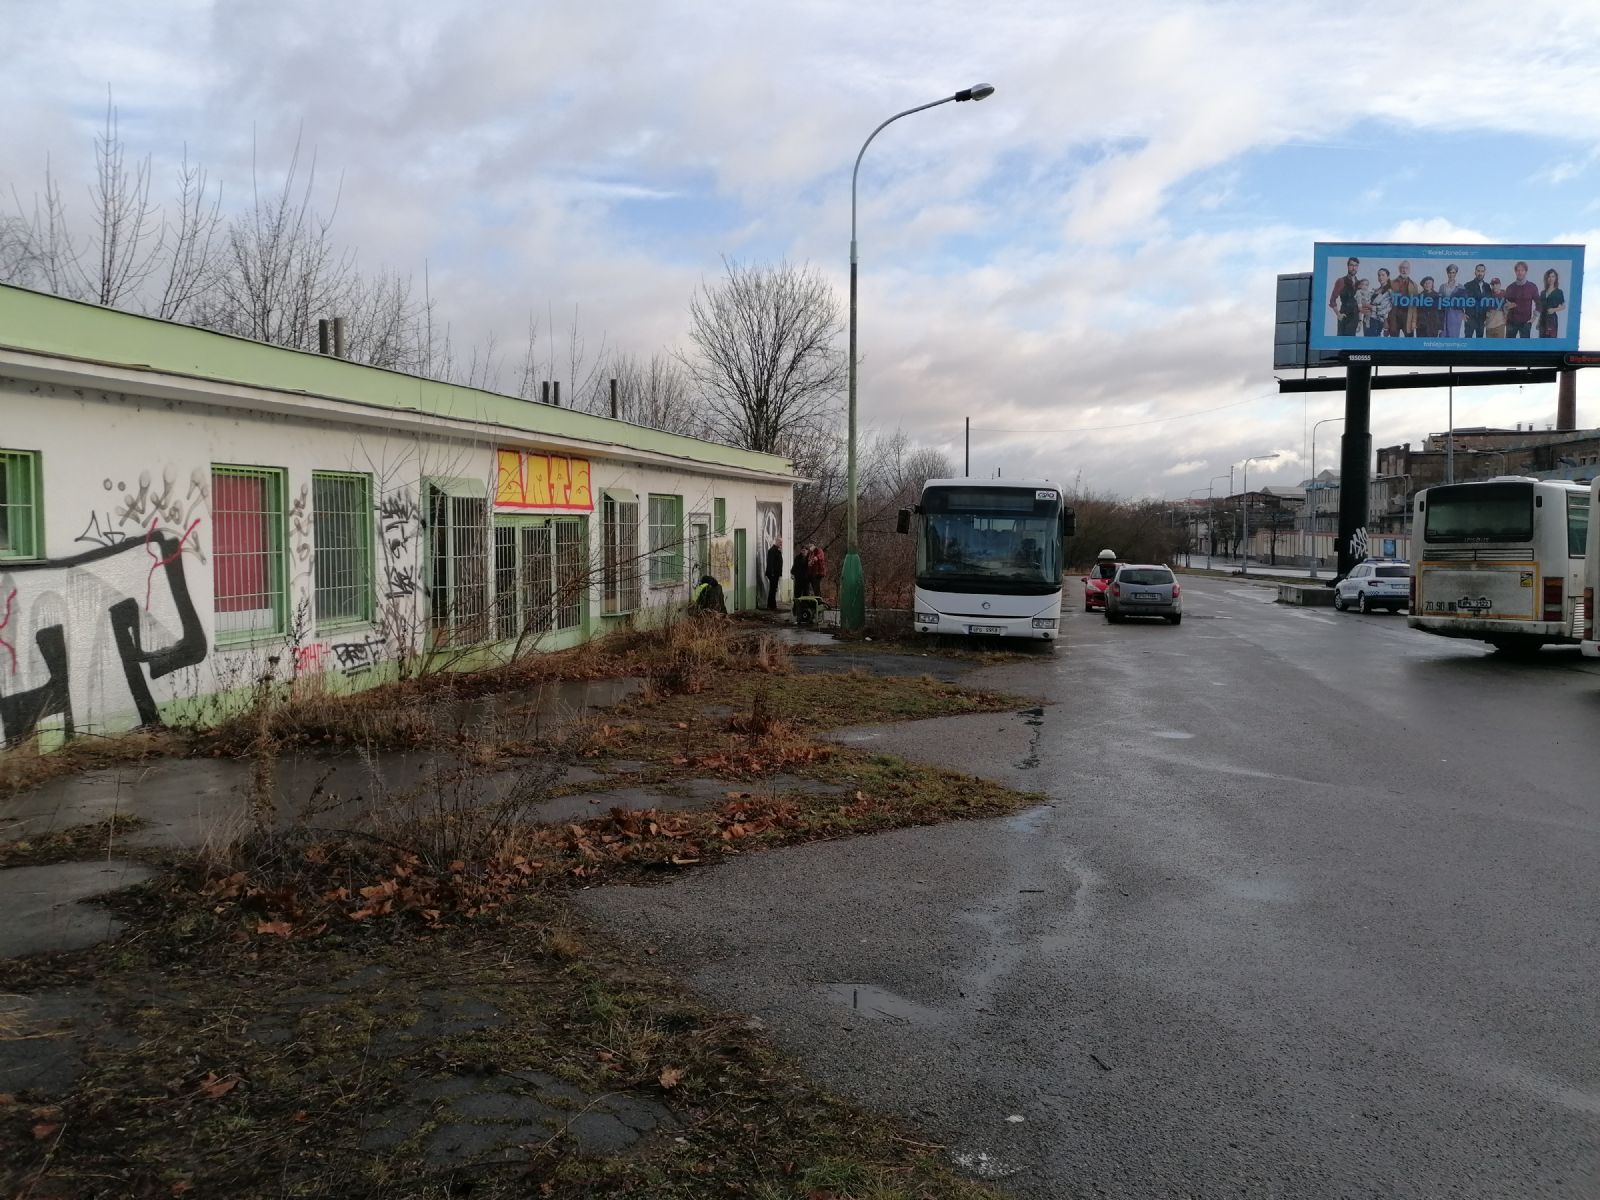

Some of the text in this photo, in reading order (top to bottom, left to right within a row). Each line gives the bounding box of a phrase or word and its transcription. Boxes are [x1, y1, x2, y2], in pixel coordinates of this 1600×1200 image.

[1391, 293, 1504, 310] Tohle jsme my
